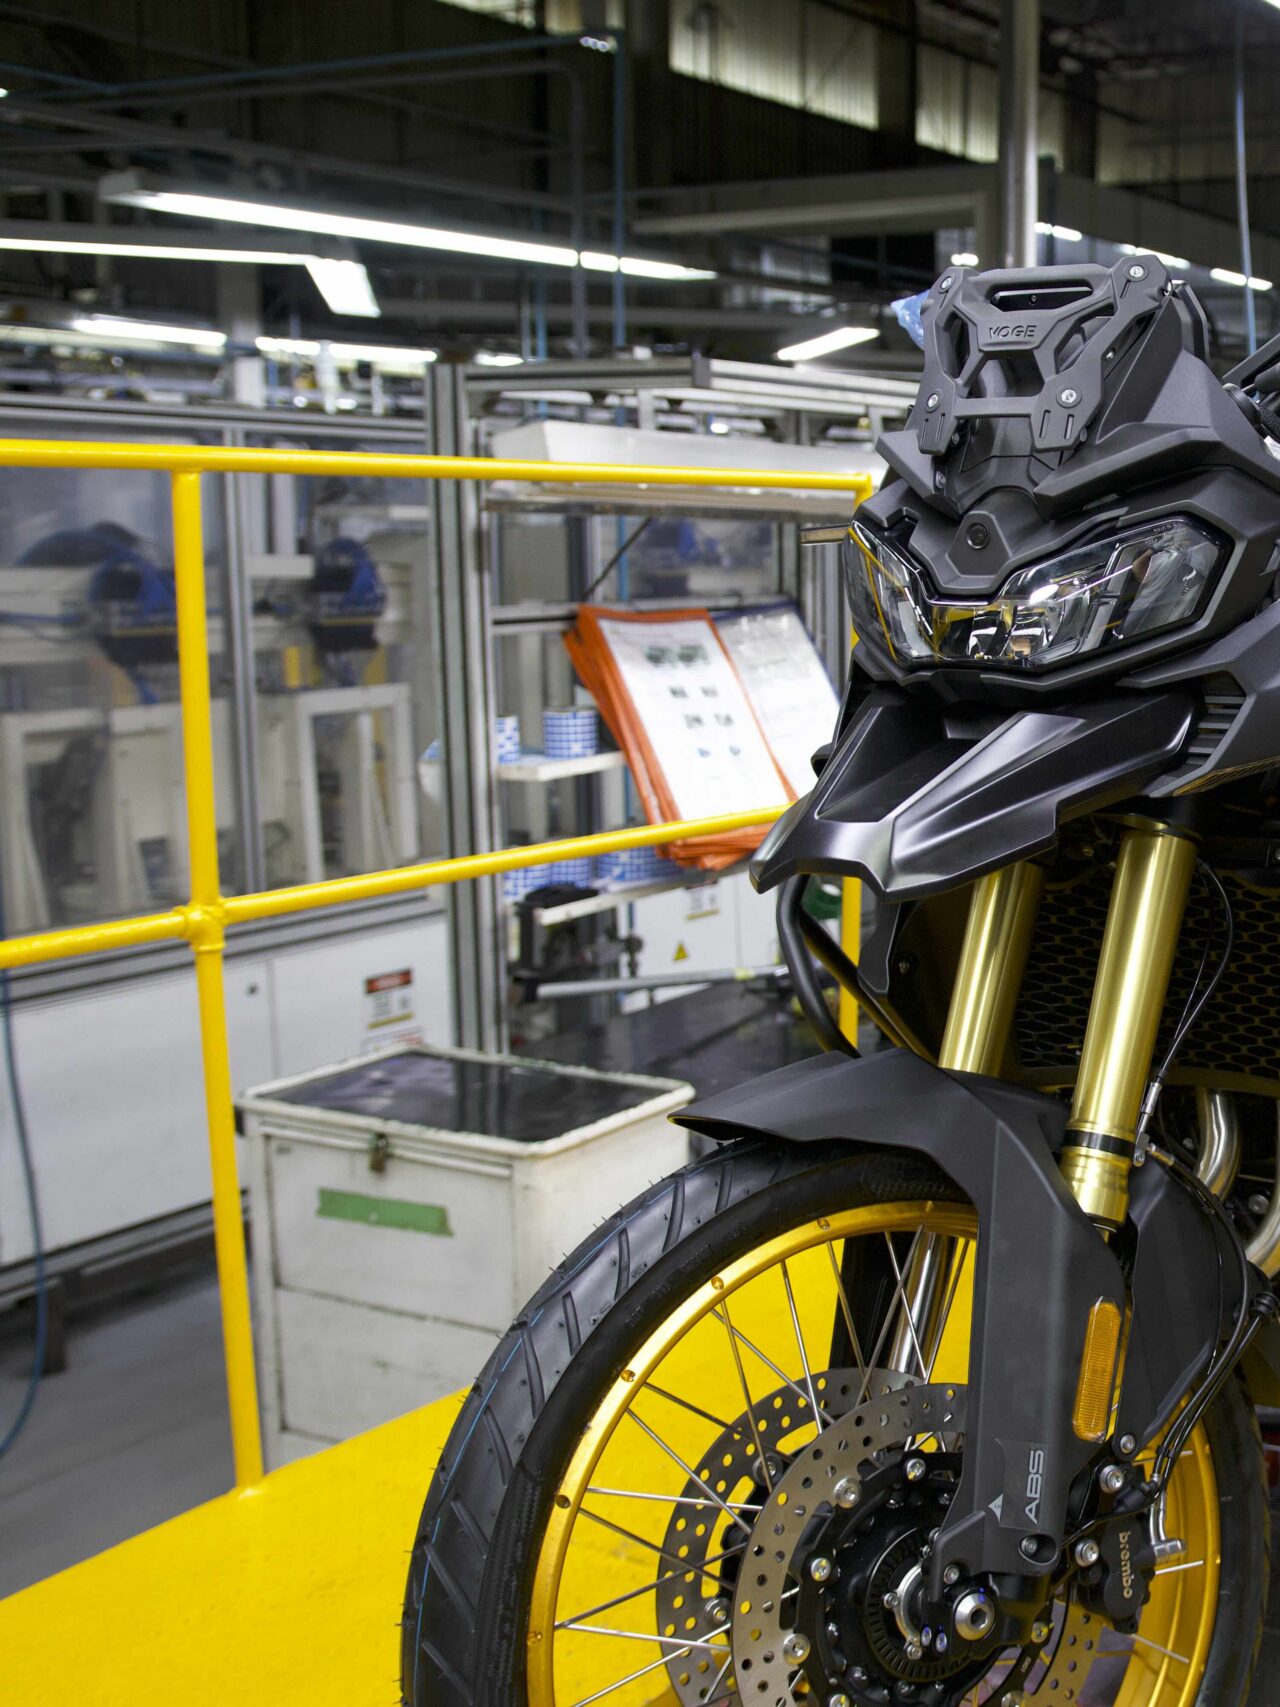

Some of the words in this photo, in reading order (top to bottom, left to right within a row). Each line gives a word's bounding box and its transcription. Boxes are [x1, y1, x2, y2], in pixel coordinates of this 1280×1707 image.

[989, 324, 1038, 340] VOGE
[1025, 1449, 1044, 1525] ABS
[1118, 1530, 1135, 1599] brembo
